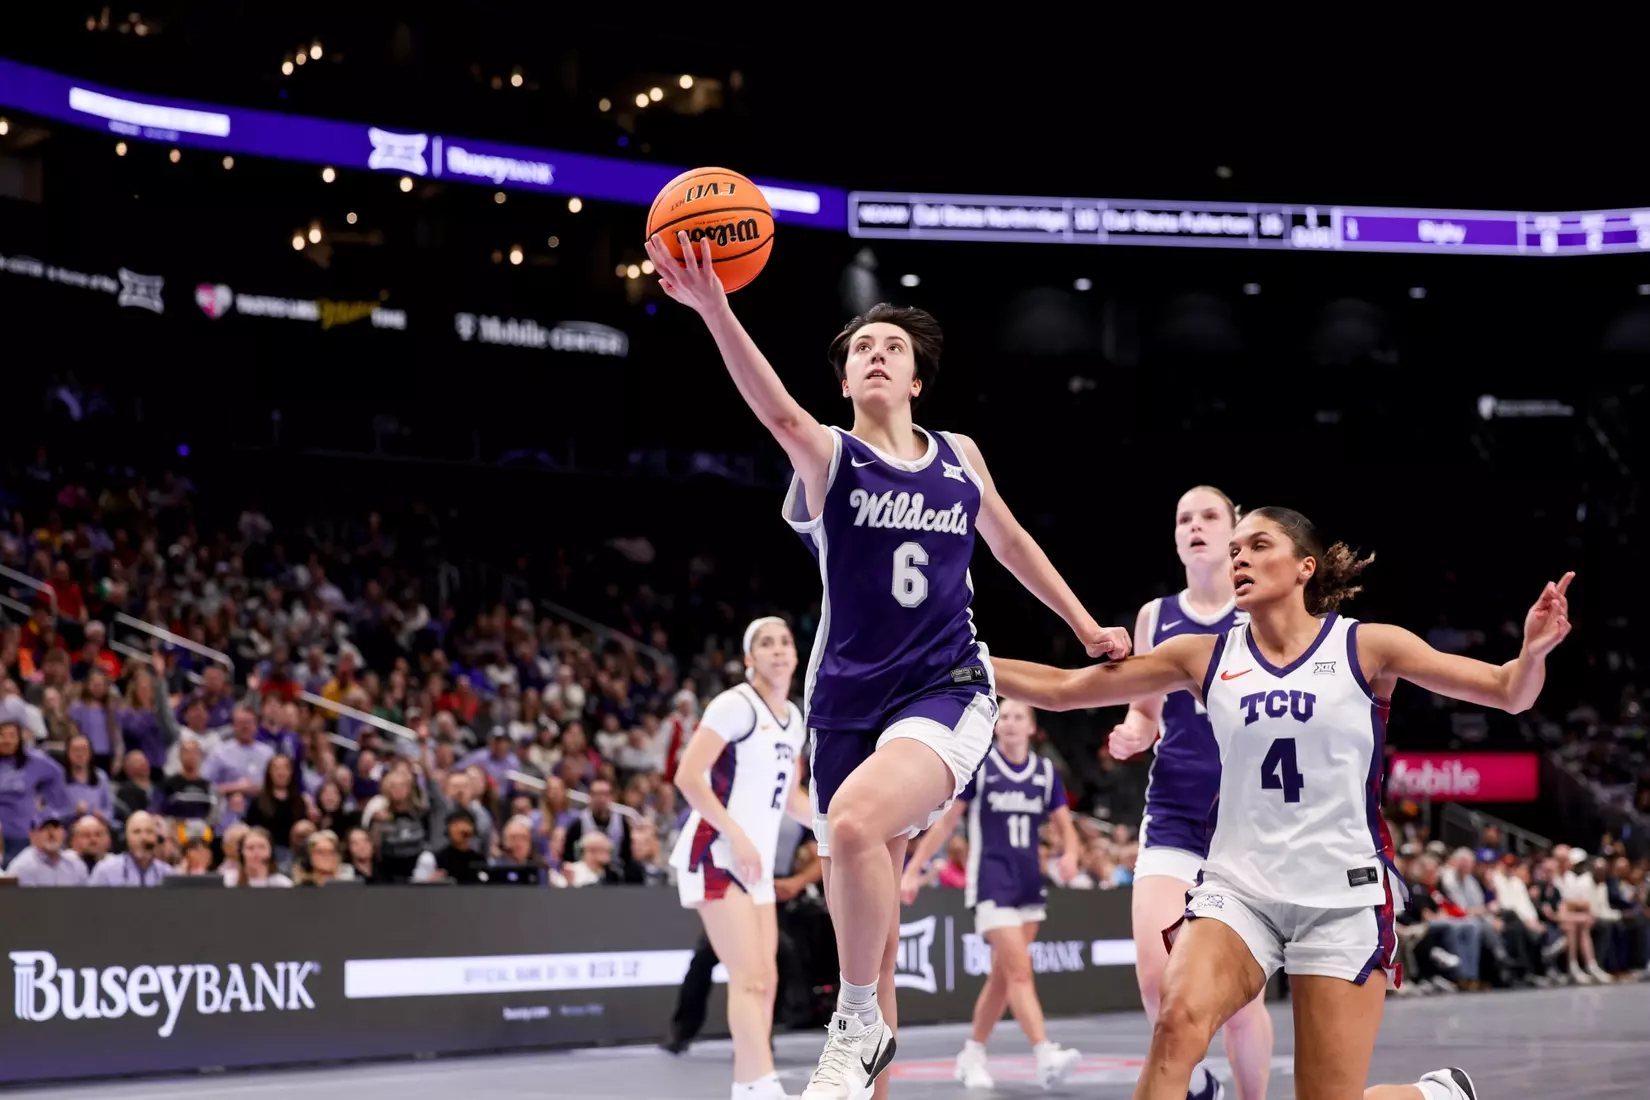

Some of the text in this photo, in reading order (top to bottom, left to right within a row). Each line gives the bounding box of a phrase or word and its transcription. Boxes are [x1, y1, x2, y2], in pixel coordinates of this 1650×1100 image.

[850, 488, 968, 535] Wildcats
[891, 541, 929, 608] 6
[1240, 690, 1316, 727] TCU
[1260, 738, 1304, 803] 4
[1007, 814, 1030, 848] 11
